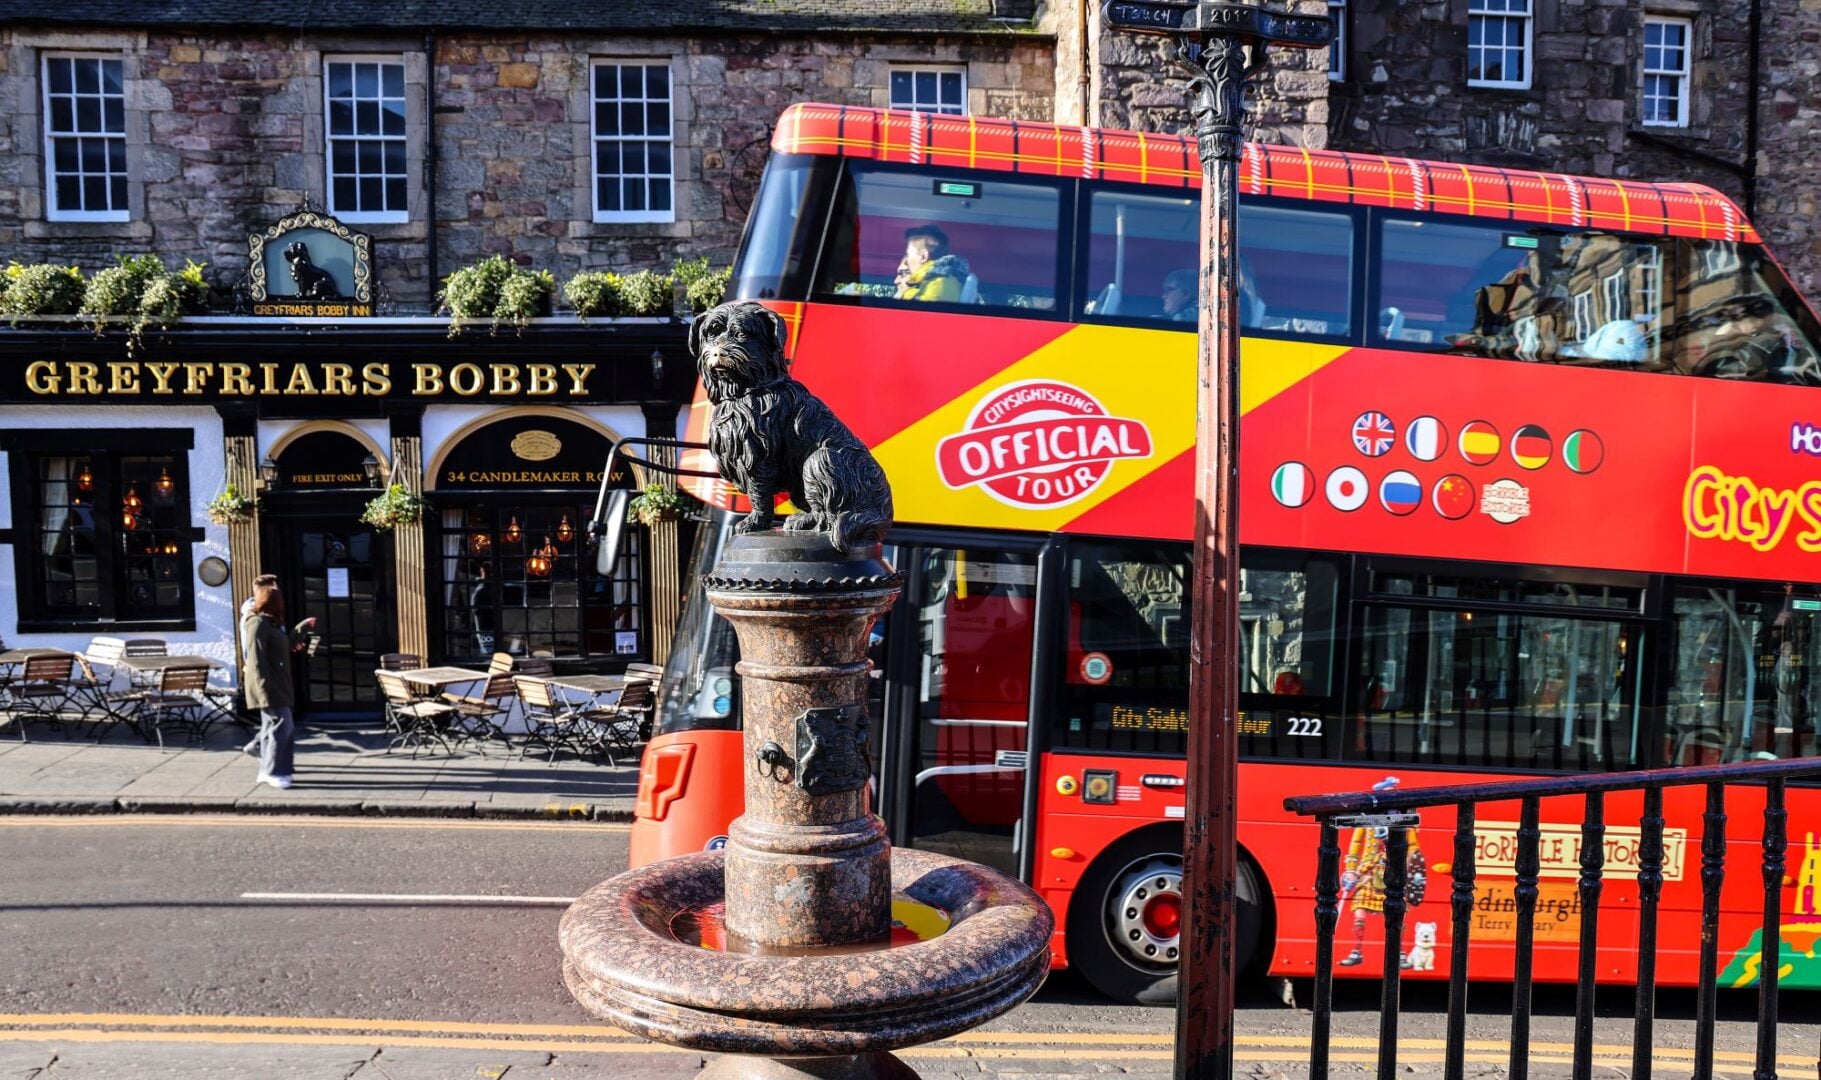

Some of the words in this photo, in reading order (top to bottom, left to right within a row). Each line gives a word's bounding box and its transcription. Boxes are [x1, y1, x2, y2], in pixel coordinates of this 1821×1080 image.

[253, 305, 313, 315] GREYFRIARS
[317, 305, 349, 316] BOBBY
[352, 305, 370, 316] INN
[25, 360, 391, 395] GREYFRIARS
[411, 363, 597, 396] BOBBY
[983, 387, 1095, 424] CITYSIGHTSEEING
[958, 424, 1141, 477] OFFICIAL
[292, 474, 313, 483] FIRE
[315, 473, 336, 483] EXIT
[337, 473, 363, 482] ONLY
[448, 472, 466, 482] 34
[469, 471, 581, 483] CANDLEMAKER
[1016, 466, 1098, 500] TOUR
[1112, 705, 1144, 728] City
[1236, 711, 1272, 734] Tour
[1286, 716, 1323, 737] 222
[1474, 835, 1564, 864] HORLE
[1472, 886, 1582, 922] dinurgh
[1476, 914, 1512, 935] Terry
